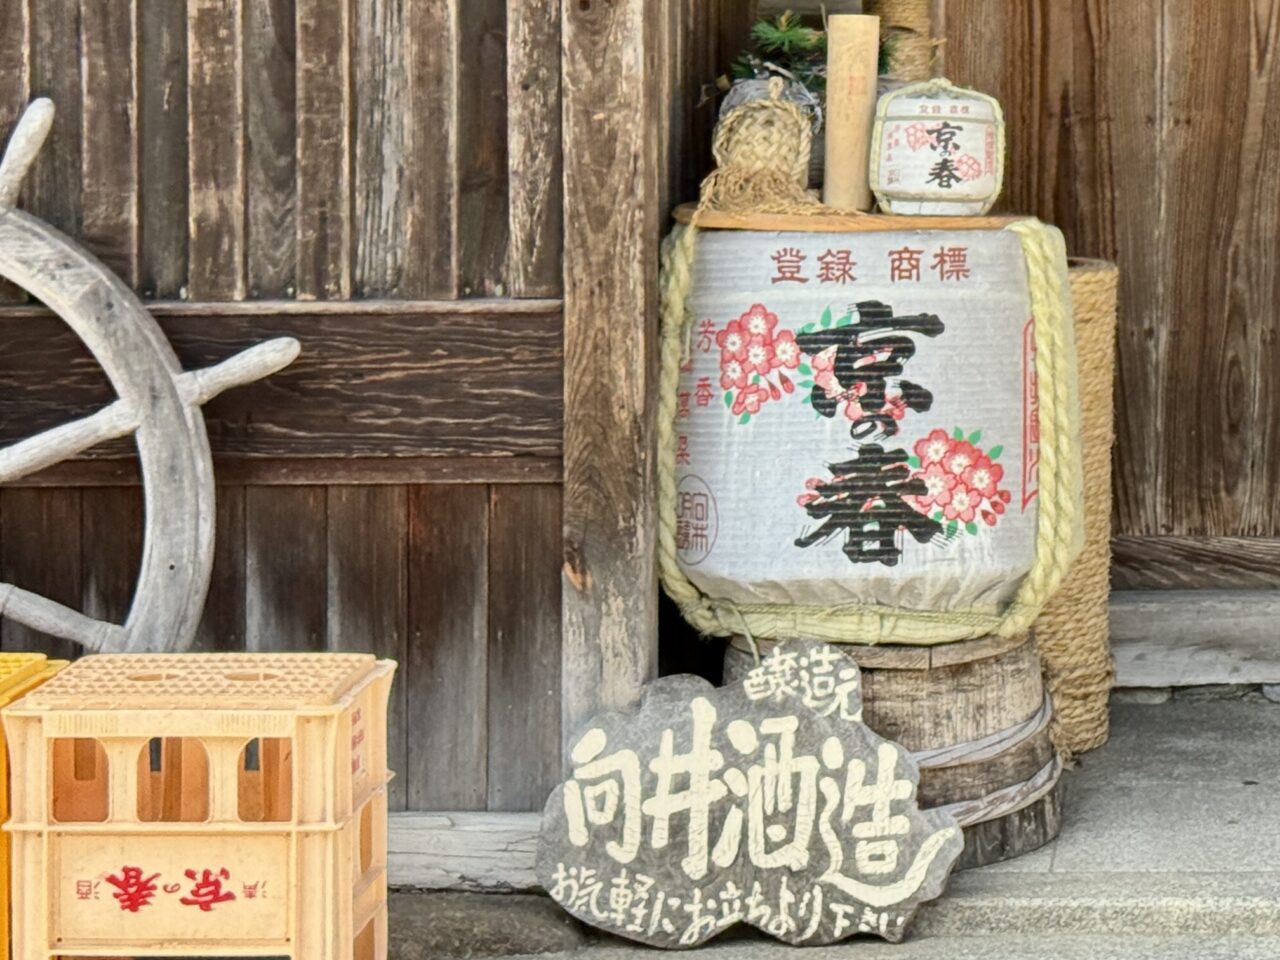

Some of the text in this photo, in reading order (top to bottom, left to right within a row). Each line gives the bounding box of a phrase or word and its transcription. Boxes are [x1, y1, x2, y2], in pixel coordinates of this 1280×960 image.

[925, 121, 963, 189] 京の春
[769, 246, 971, 286] 登録 商標
[794, 300, 947, 567] 京の春
[743, 645, 862, 722] 醸造元
[563, 696, 957, 907] 向井酒造
[76, 880, 100, 900] 酒
[106, 865, 237, 913] 京の春
[550, 862, 904, 944] お気軽にお立ちより下さい
